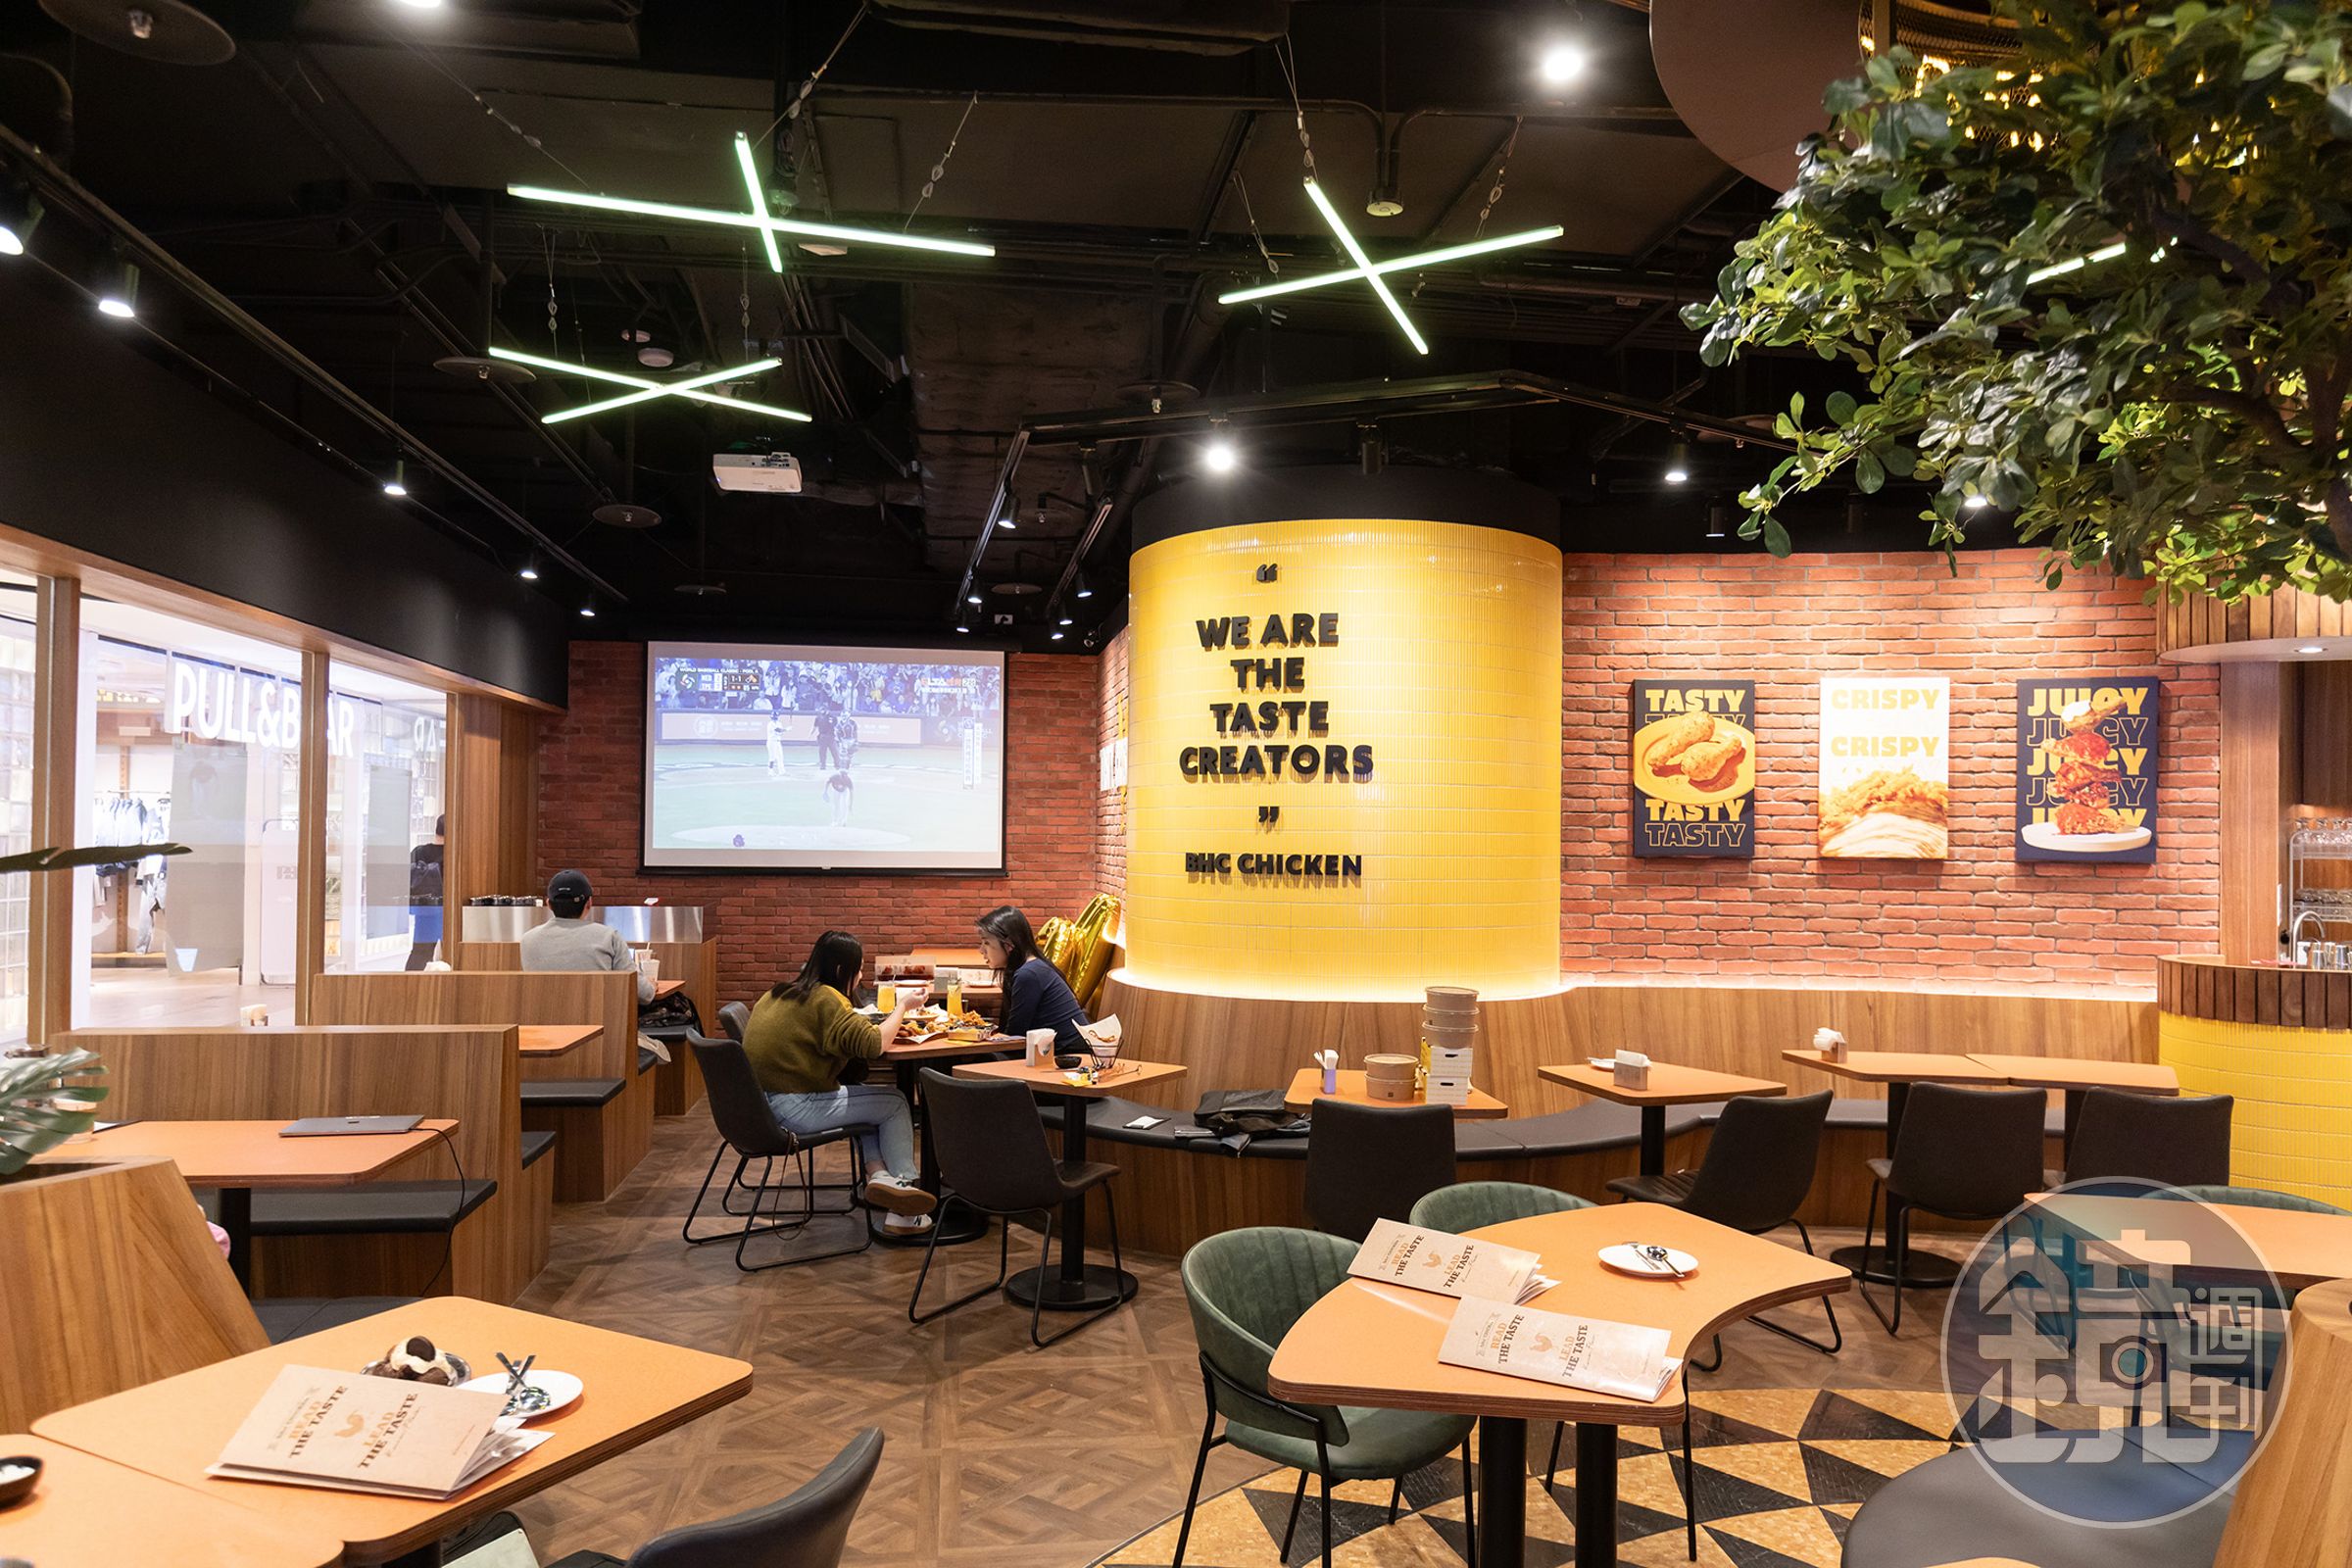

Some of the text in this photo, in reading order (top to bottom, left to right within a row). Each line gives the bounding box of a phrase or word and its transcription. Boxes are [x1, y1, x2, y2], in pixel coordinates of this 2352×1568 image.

[1196, 612, 1339, 648] WE ARE
[1231, 657, 1304, 690] THE
[173, 662, 354, 759] PULL&BAR
[1644, 689, 1745, 712] TASTY
[1831, 689, 1939, 710] CRISPY
[1209, 701, 1329, 733] TASTE
[2027, 717, 2149, 746] JUCY
[1179, 744, 1374, 777] CREATORS
[1831, 736, 1939, 758] CRISPY
[1644, 799, 1745, 821] TASTY
[1644, 822, 1746, 848] TASTY
[1185, 852, 1362, 876] BHC CHICKEN
[1395, 1235, 1425, 1276] THE TASTE
[1444, 1270, 1460, 1288] THE
[1456, 1245, 1474, 1270] TASTE
[1445, 1254, 1460, 1275] LEAD
[1498, 1314, 1524, 1364] THE TASTE
[1559, 1335, 1575, 1360] LEAD
[1562, 1325, 1588, 1377] THE TASTE
[289, 1430, 314, 1458] THE
[310, 1386, 348, 1427] TASTE
[358, 1439, 387, 1468] THE
[385, 1393, 418, 1435] TASTE
[363, 1411, 394, 1446] LEAD
